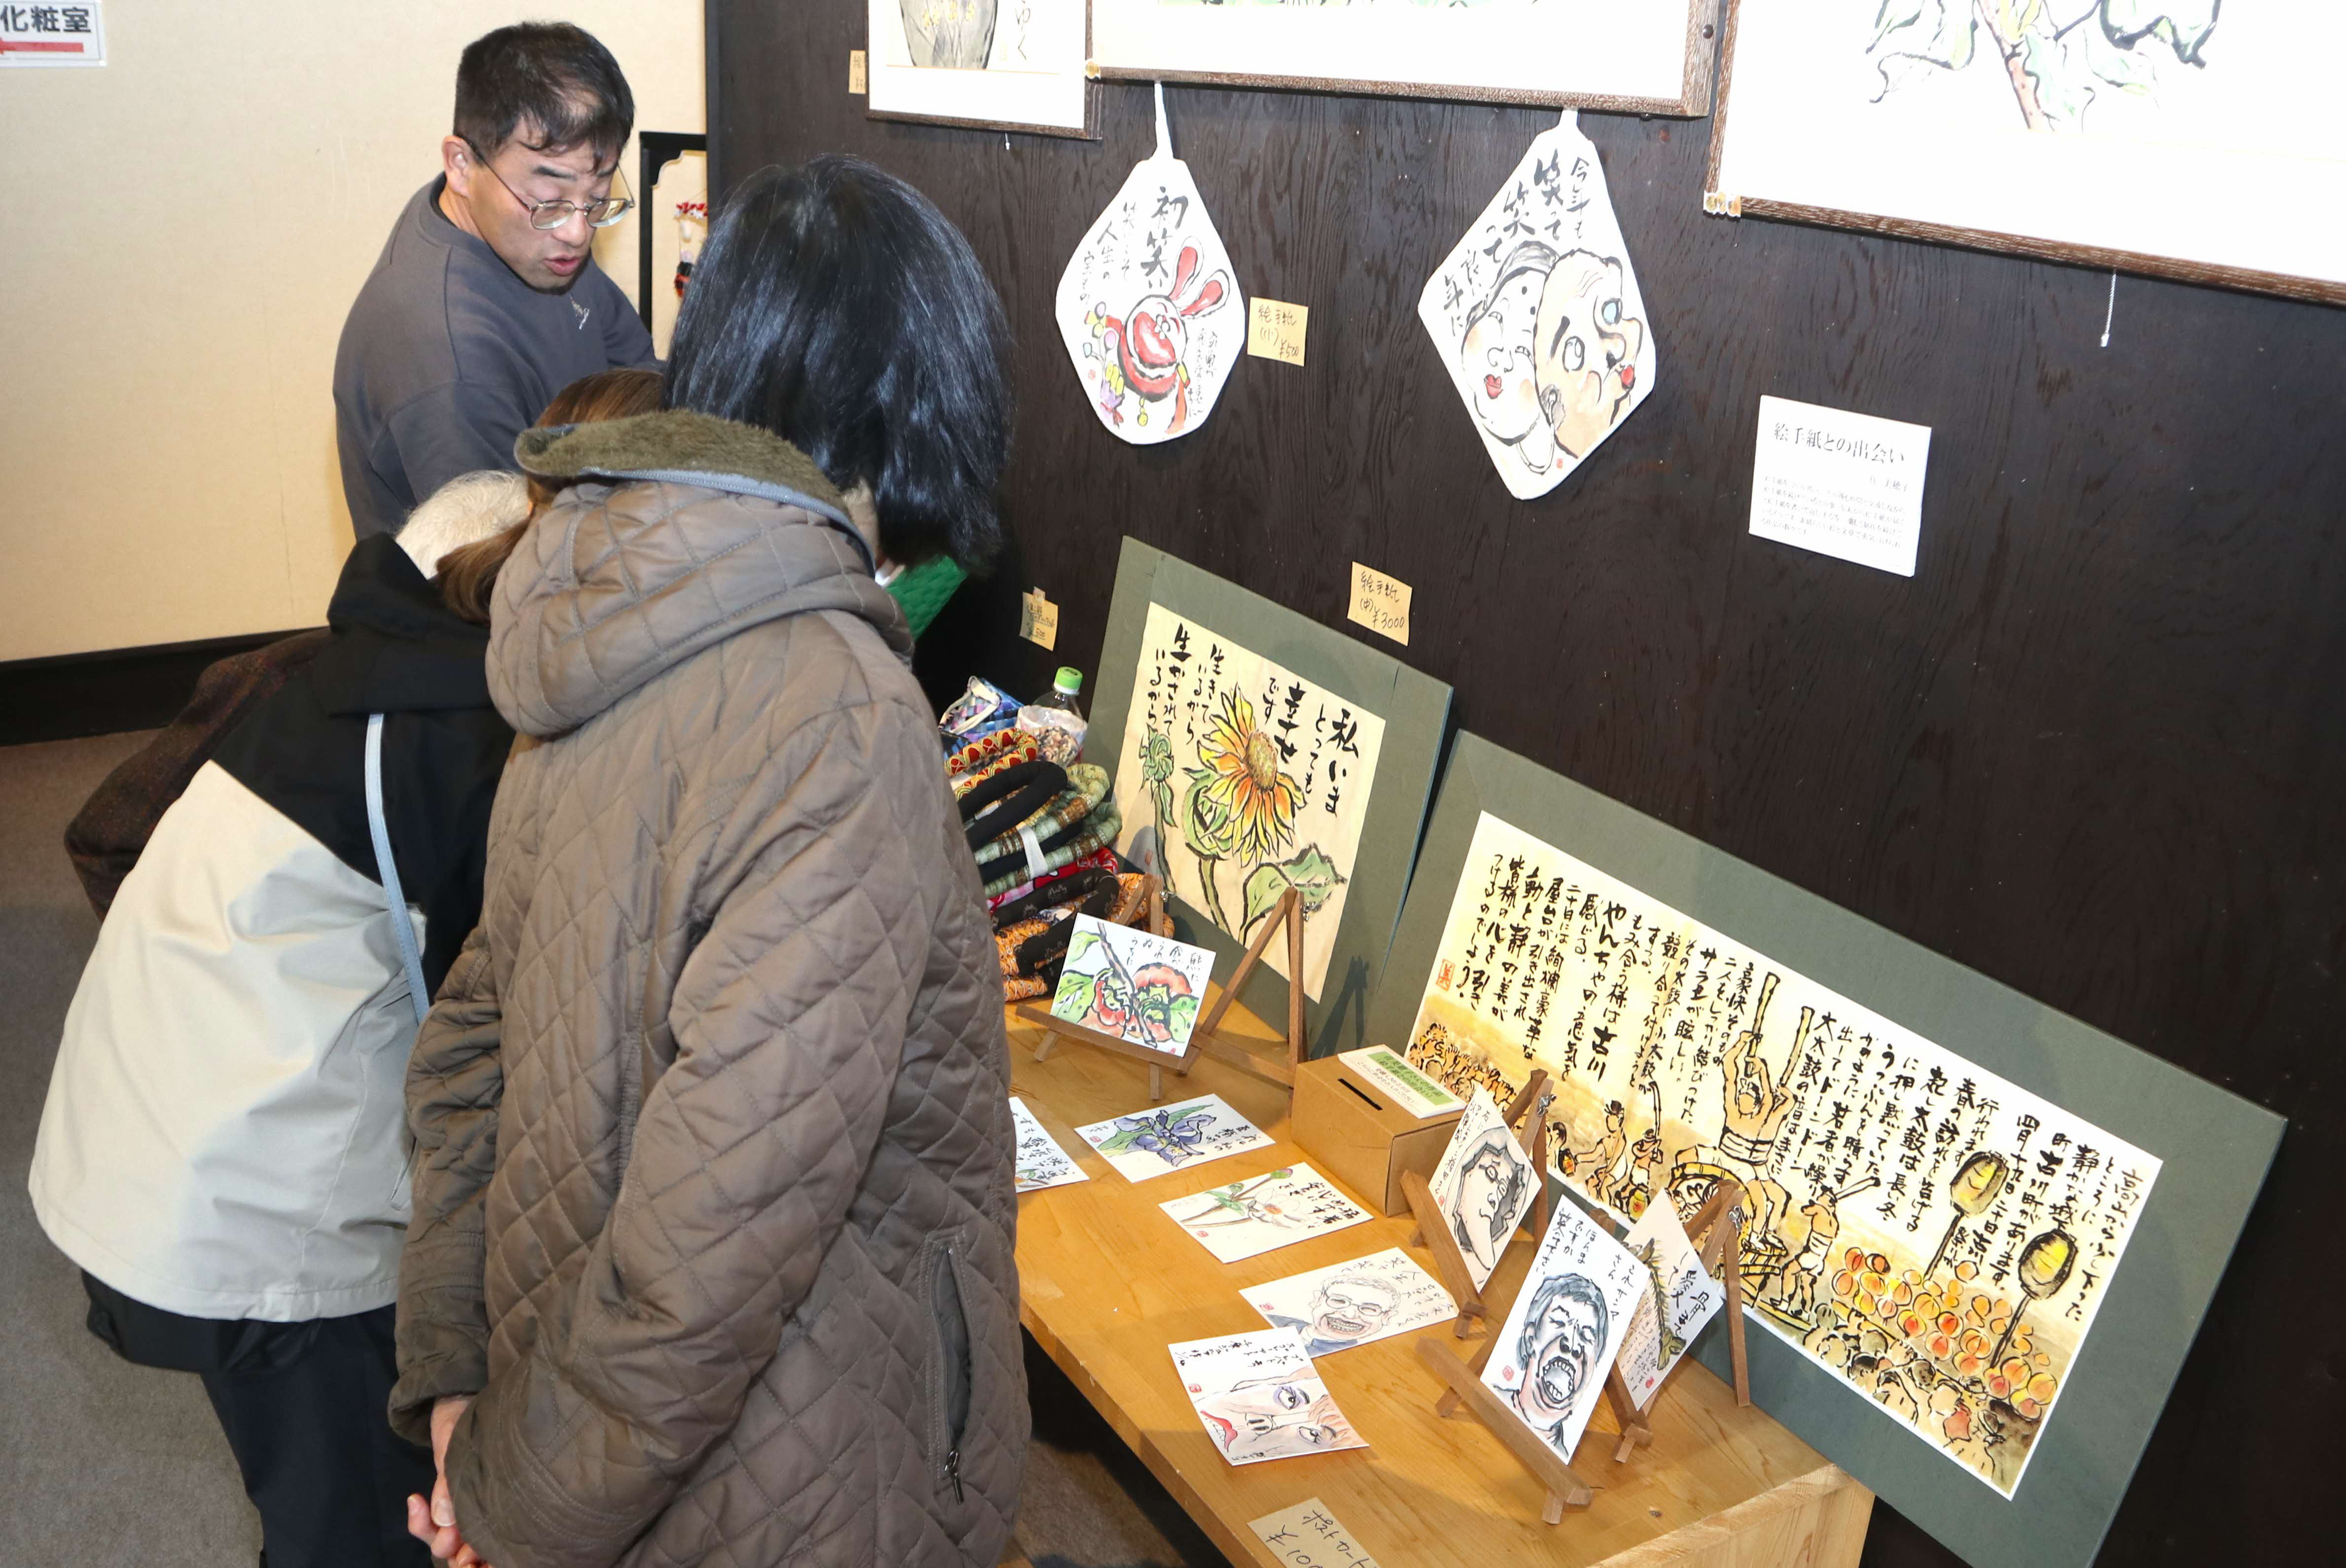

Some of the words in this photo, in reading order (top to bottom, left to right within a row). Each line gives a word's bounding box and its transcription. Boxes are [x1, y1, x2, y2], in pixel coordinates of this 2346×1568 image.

[0, 5, 92, 33] 化粧室
[1483, 180, 1535, 264] 笑って
[1534, 148, 1564, 241] 笑って
[1566, 156, 1590, 240] 今年も
[1097, 220, 1118, 279] 人生の
[1140, 186, 1189, 289] 初笑い
[1258, 305, 1297, 326] 絵手紙
[1774, 422, 1905, 464] 絵手紙との出会い
[1360, 571, 1400, 603] 絵手紙
[1372, 605, 1405, 629] ¥3000
[1147, 648, 1166, 725] いるから
[1163, 622, 1192, 737] 生かされて
[1186, 663, 1207, 746] いるから
[1199, 643, 1226, 725] 生きて
[1261, 676, 1280, 726] です
[1273, 681, 1307, 766] 幸せ
[1305, 703, 1326, 796] とっても
[1326, 707, 1359, 818] 私いま
[2082, 1157, 2113, 1223] ところに
[1563, 1219, 1584, 1257] ですか
[1577, 1229, 1598, 1265] ほんま
[1608, 1254, 1622, 1281] さん
[1610, 1263, 1636, 1322] これサンマ
[1266, 1524, 1323, 1568] ¥10
